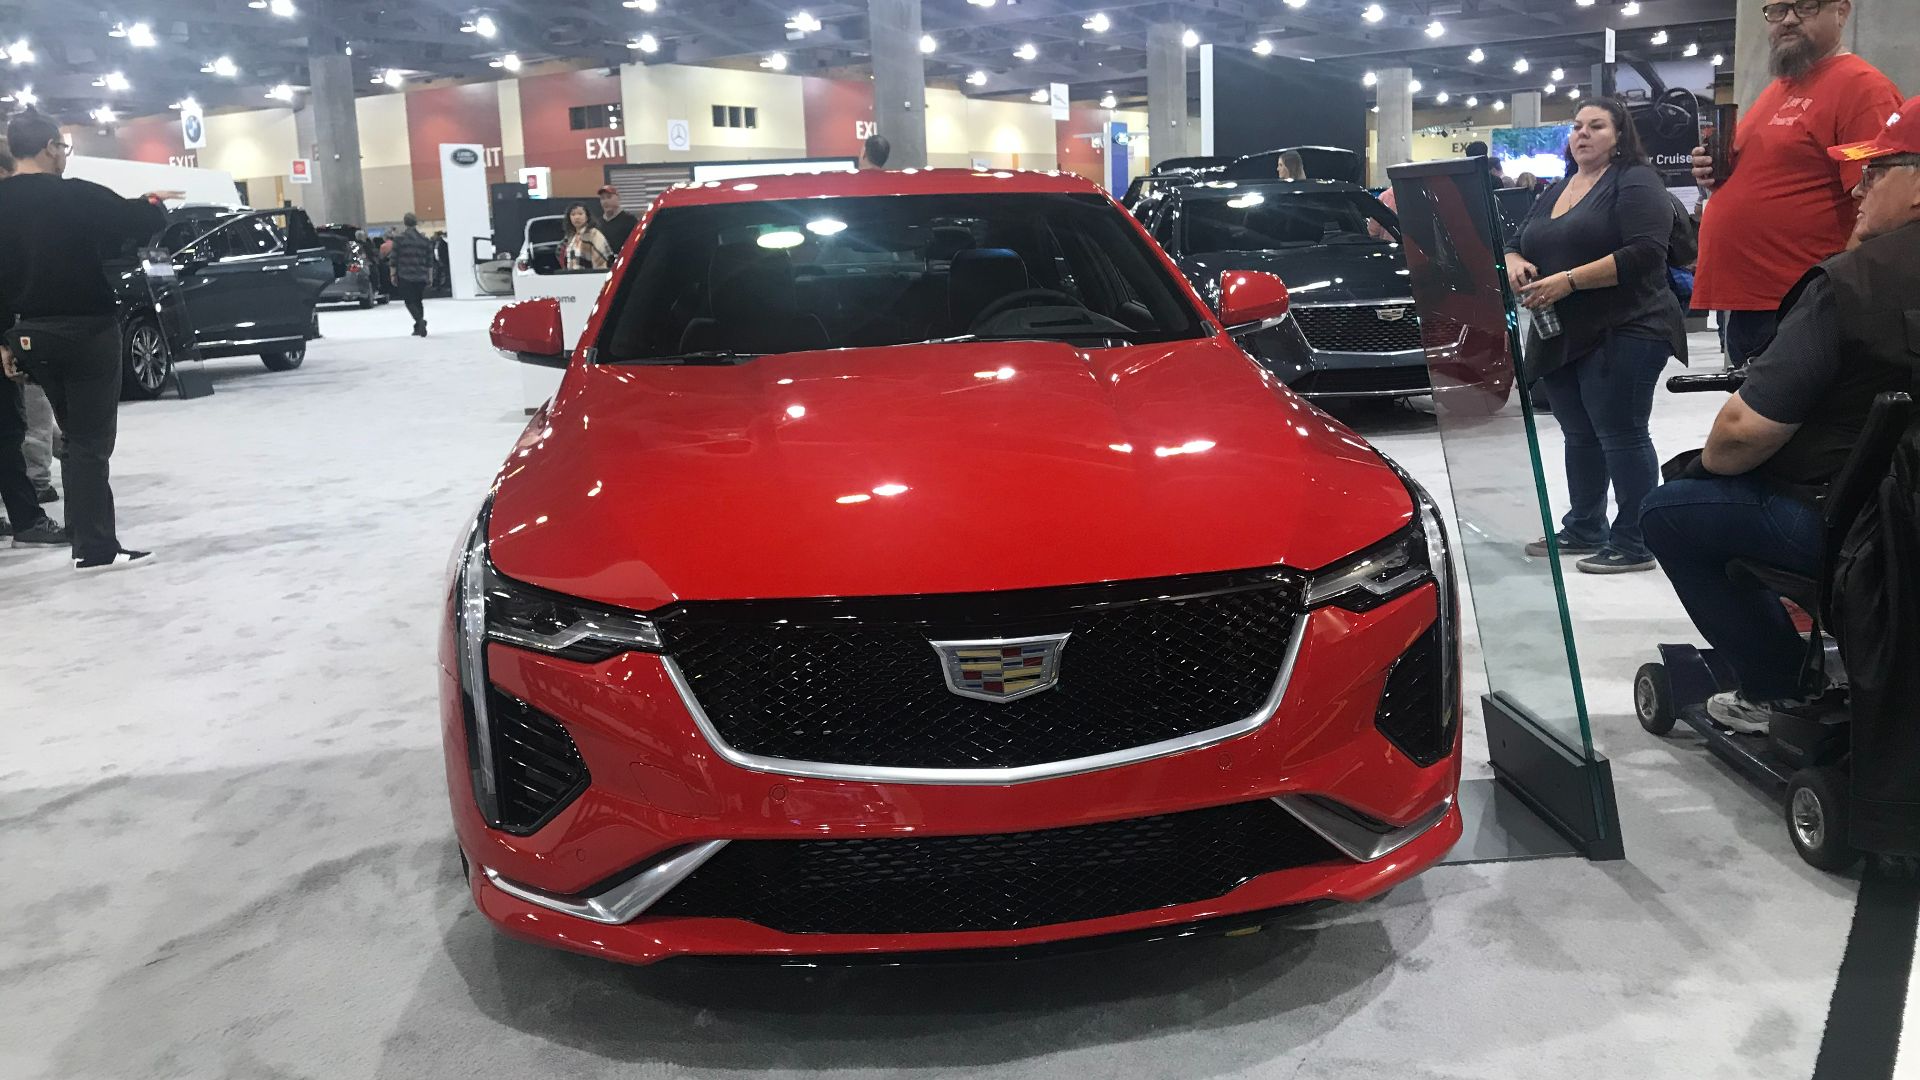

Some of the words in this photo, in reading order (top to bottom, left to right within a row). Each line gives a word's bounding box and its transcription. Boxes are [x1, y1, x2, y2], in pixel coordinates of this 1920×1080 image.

[855, 120, 878, 140] EXI
[485, 147, 501, 167] IT
[586, 136, 625, 160] EXIT
[168, 154, 196, 168] EXIT
[1656, 152, 1693, 165] Cruise
